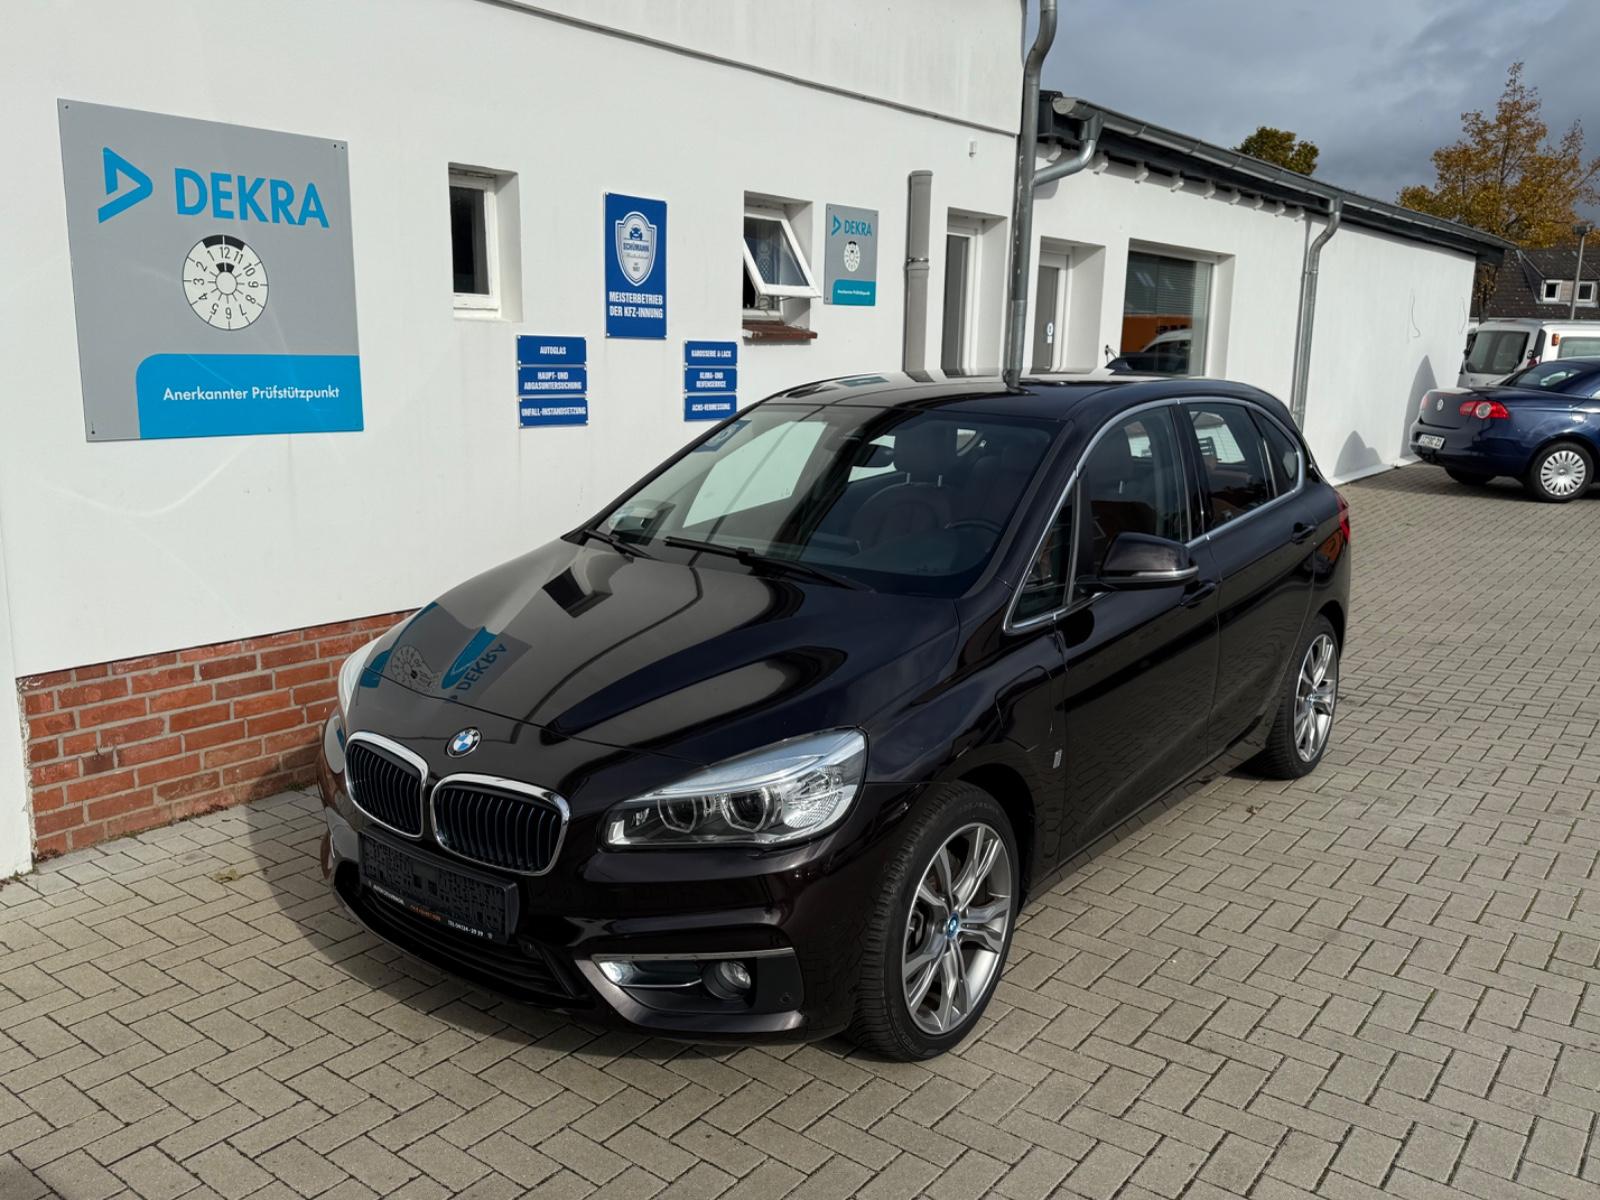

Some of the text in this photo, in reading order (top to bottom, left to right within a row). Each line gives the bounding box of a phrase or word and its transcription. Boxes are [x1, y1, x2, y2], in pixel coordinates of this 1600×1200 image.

[174, 167, 330, 229] DEKRA
[844, 219, 872, 237] DEKRA
[207, 250, 214, 261] 1
[220, 247, 230, 259] 12
[234, 251, 243, 264] 11
[196, 262, 207, 272] 2
[243, 263, 256, 277] 10
[245, 294, 256, 304] 8
[609, 291, 663, 305] MEISTERBETRIEB
[210, 303, 219, 315] 5
[225, 307, 232, 319] 6
[239, 304, 247, 316] 7
[609, 306, 664, 318] DER KFZ-INNUNG
[540, 346, 566, 354] AUTOGLAS
[538, 372, 556, 380] HAUPT-
[524, 382, 582, 390] ABGASUNTERSUCHUNG
[163, 385, 340, 402] Anerkannter Prüfstützpunkt
